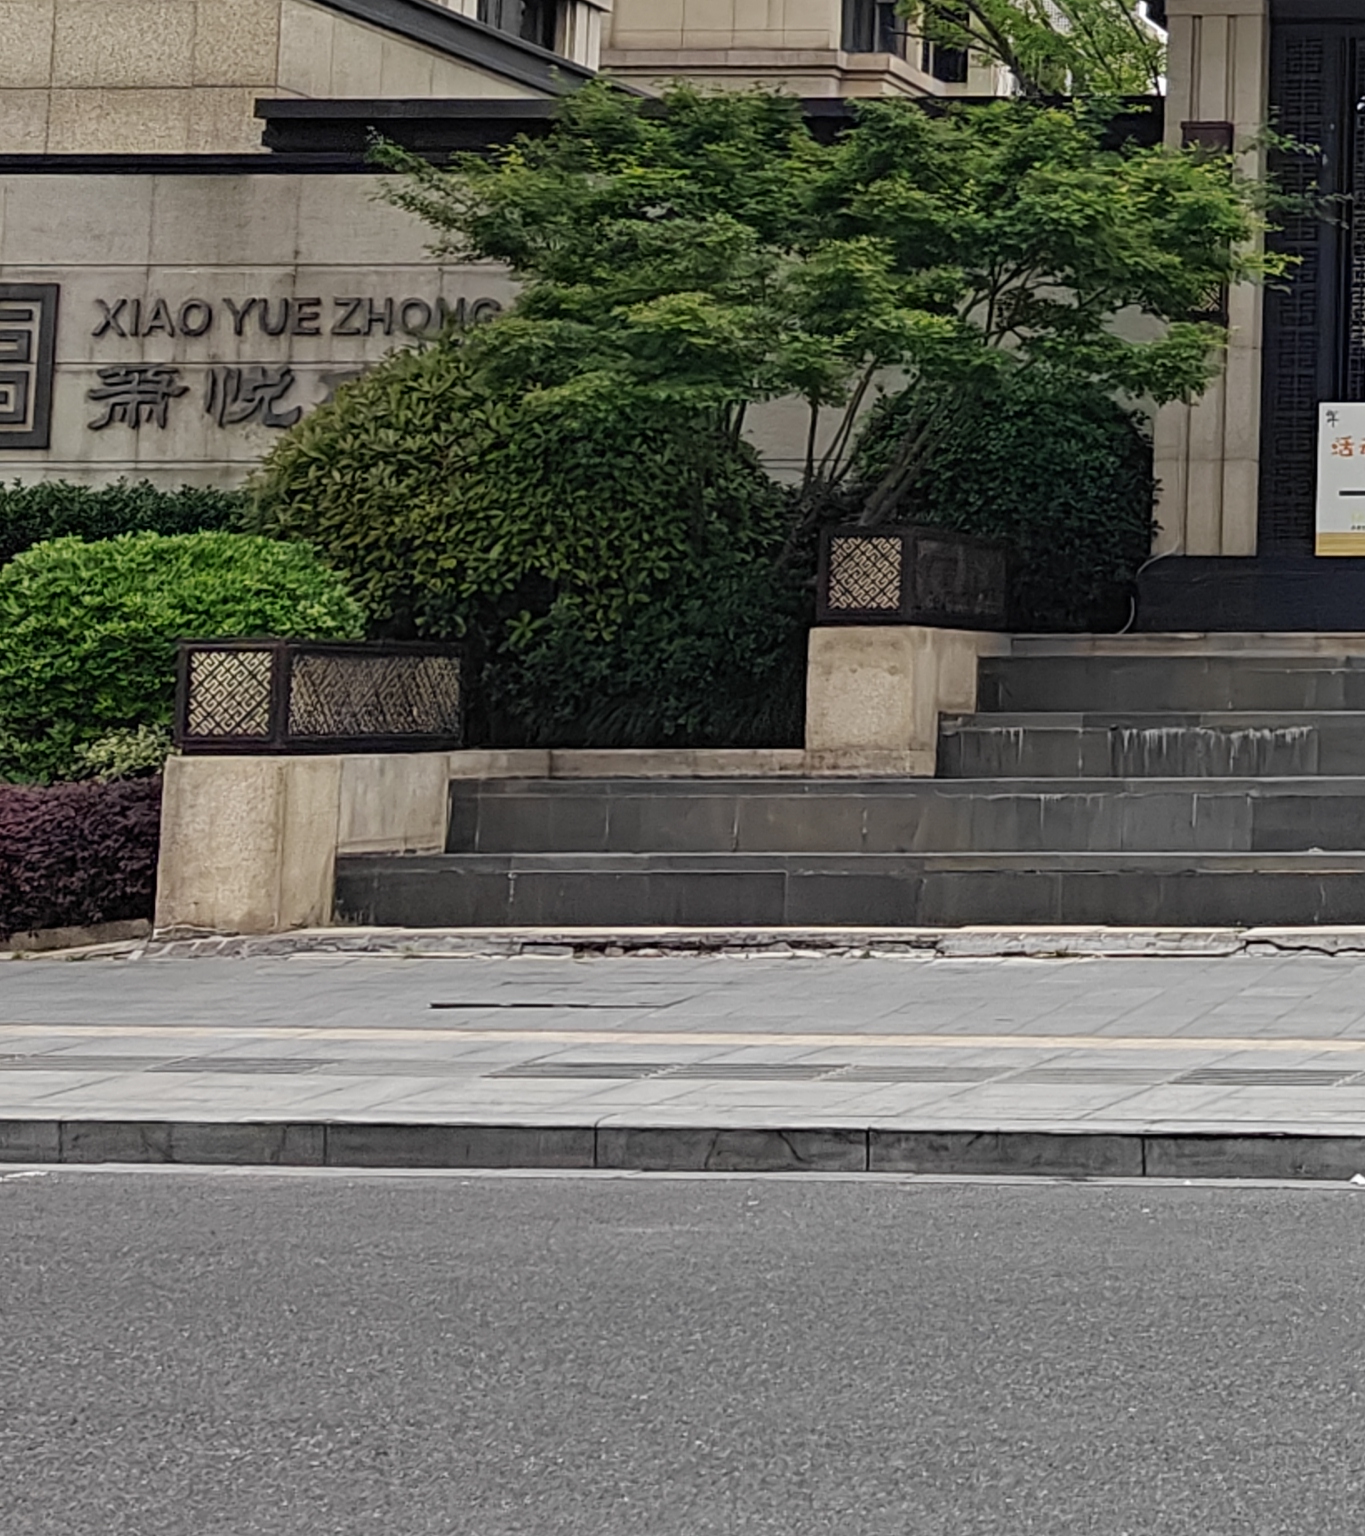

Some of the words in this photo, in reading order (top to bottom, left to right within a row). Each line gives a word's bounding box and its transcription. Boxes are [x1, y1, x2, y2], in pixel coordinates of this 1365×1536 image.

[91, 297, 213, 337] XIAO
[221, 296, 322, 336] YUE
[87, 364, 364, 430] 萧悦
